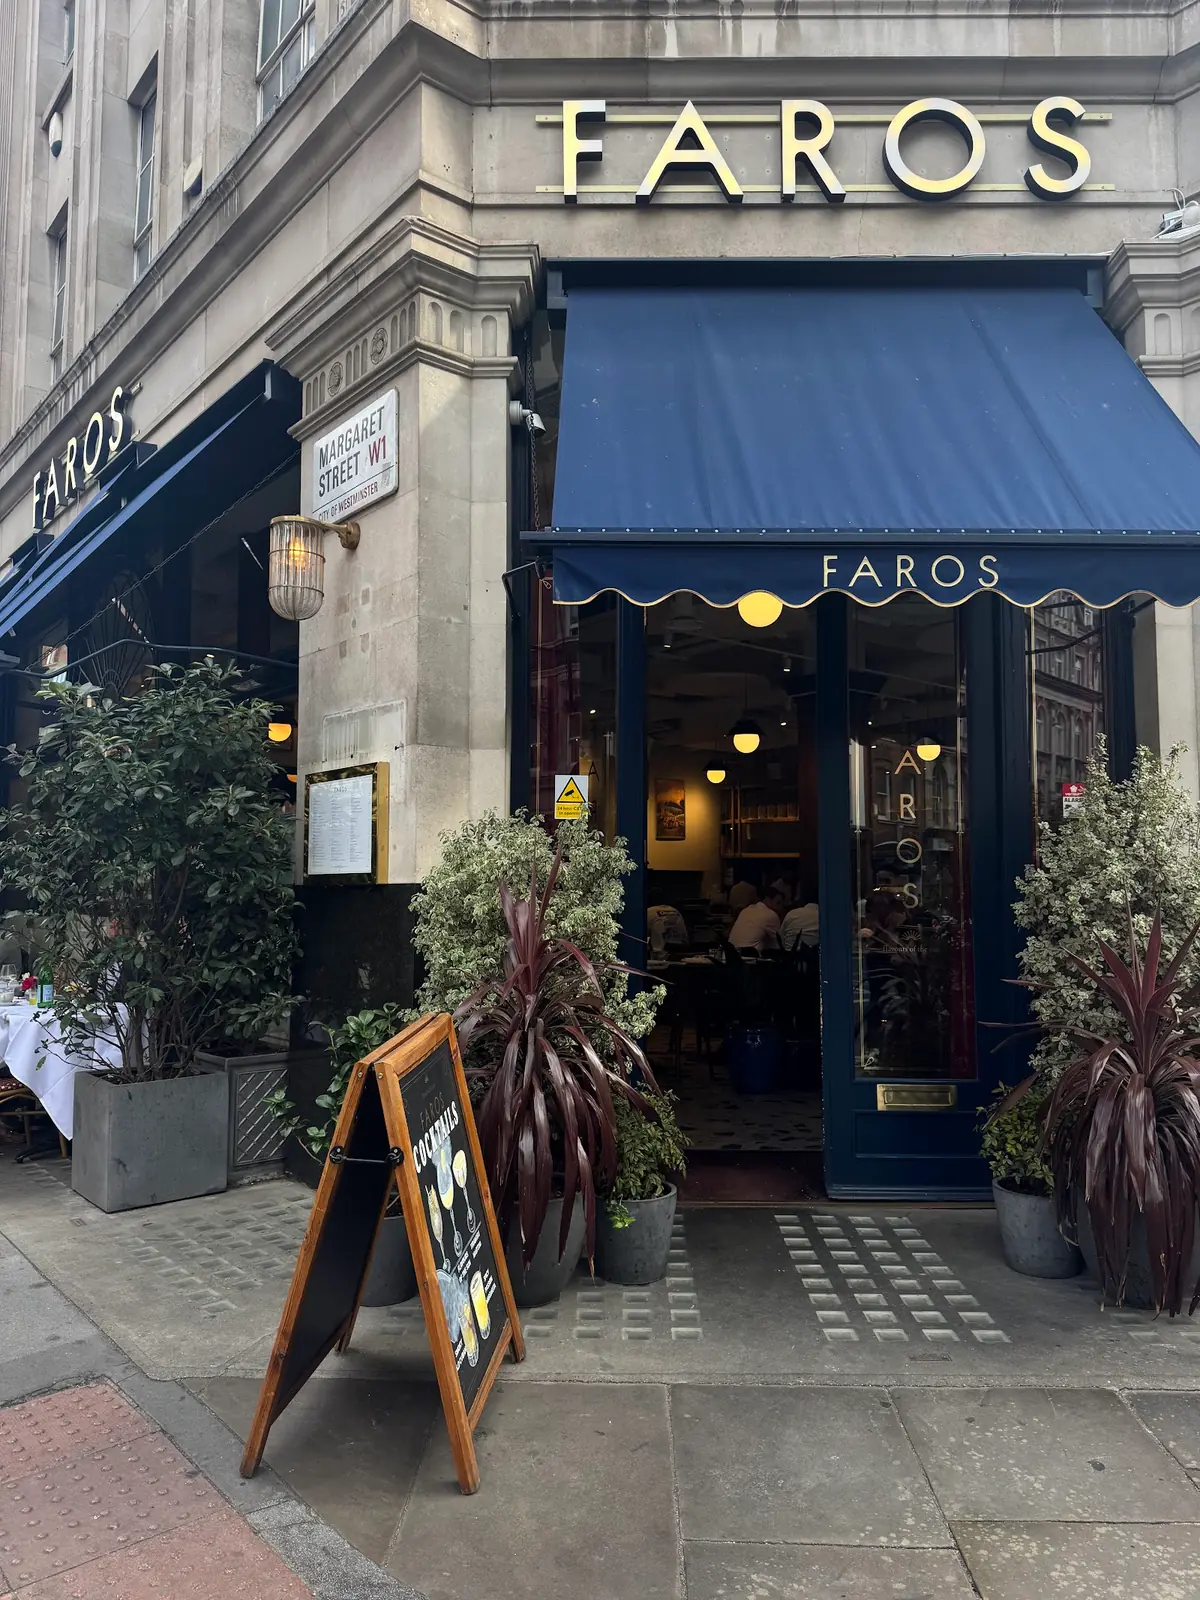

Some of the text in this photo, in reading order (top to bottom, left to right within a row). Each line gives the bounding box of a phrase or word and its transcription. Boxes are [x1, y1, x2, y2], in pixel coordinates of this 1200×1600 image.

[562, 96, 1092, 204] FAROS
[33, 386, 128, 529] FAROS
[319, 405, 385, 470] MARGARET
[319, 435, 387, 498] STREET W1
[318, 481, 379, 523] CITY OF WESTMINSTER
[822, 554, 1000, 589] FAROS
[413, 1100, 459, 1174] COCKTAILS
[419, 1091, 446, 1131] FAROS
